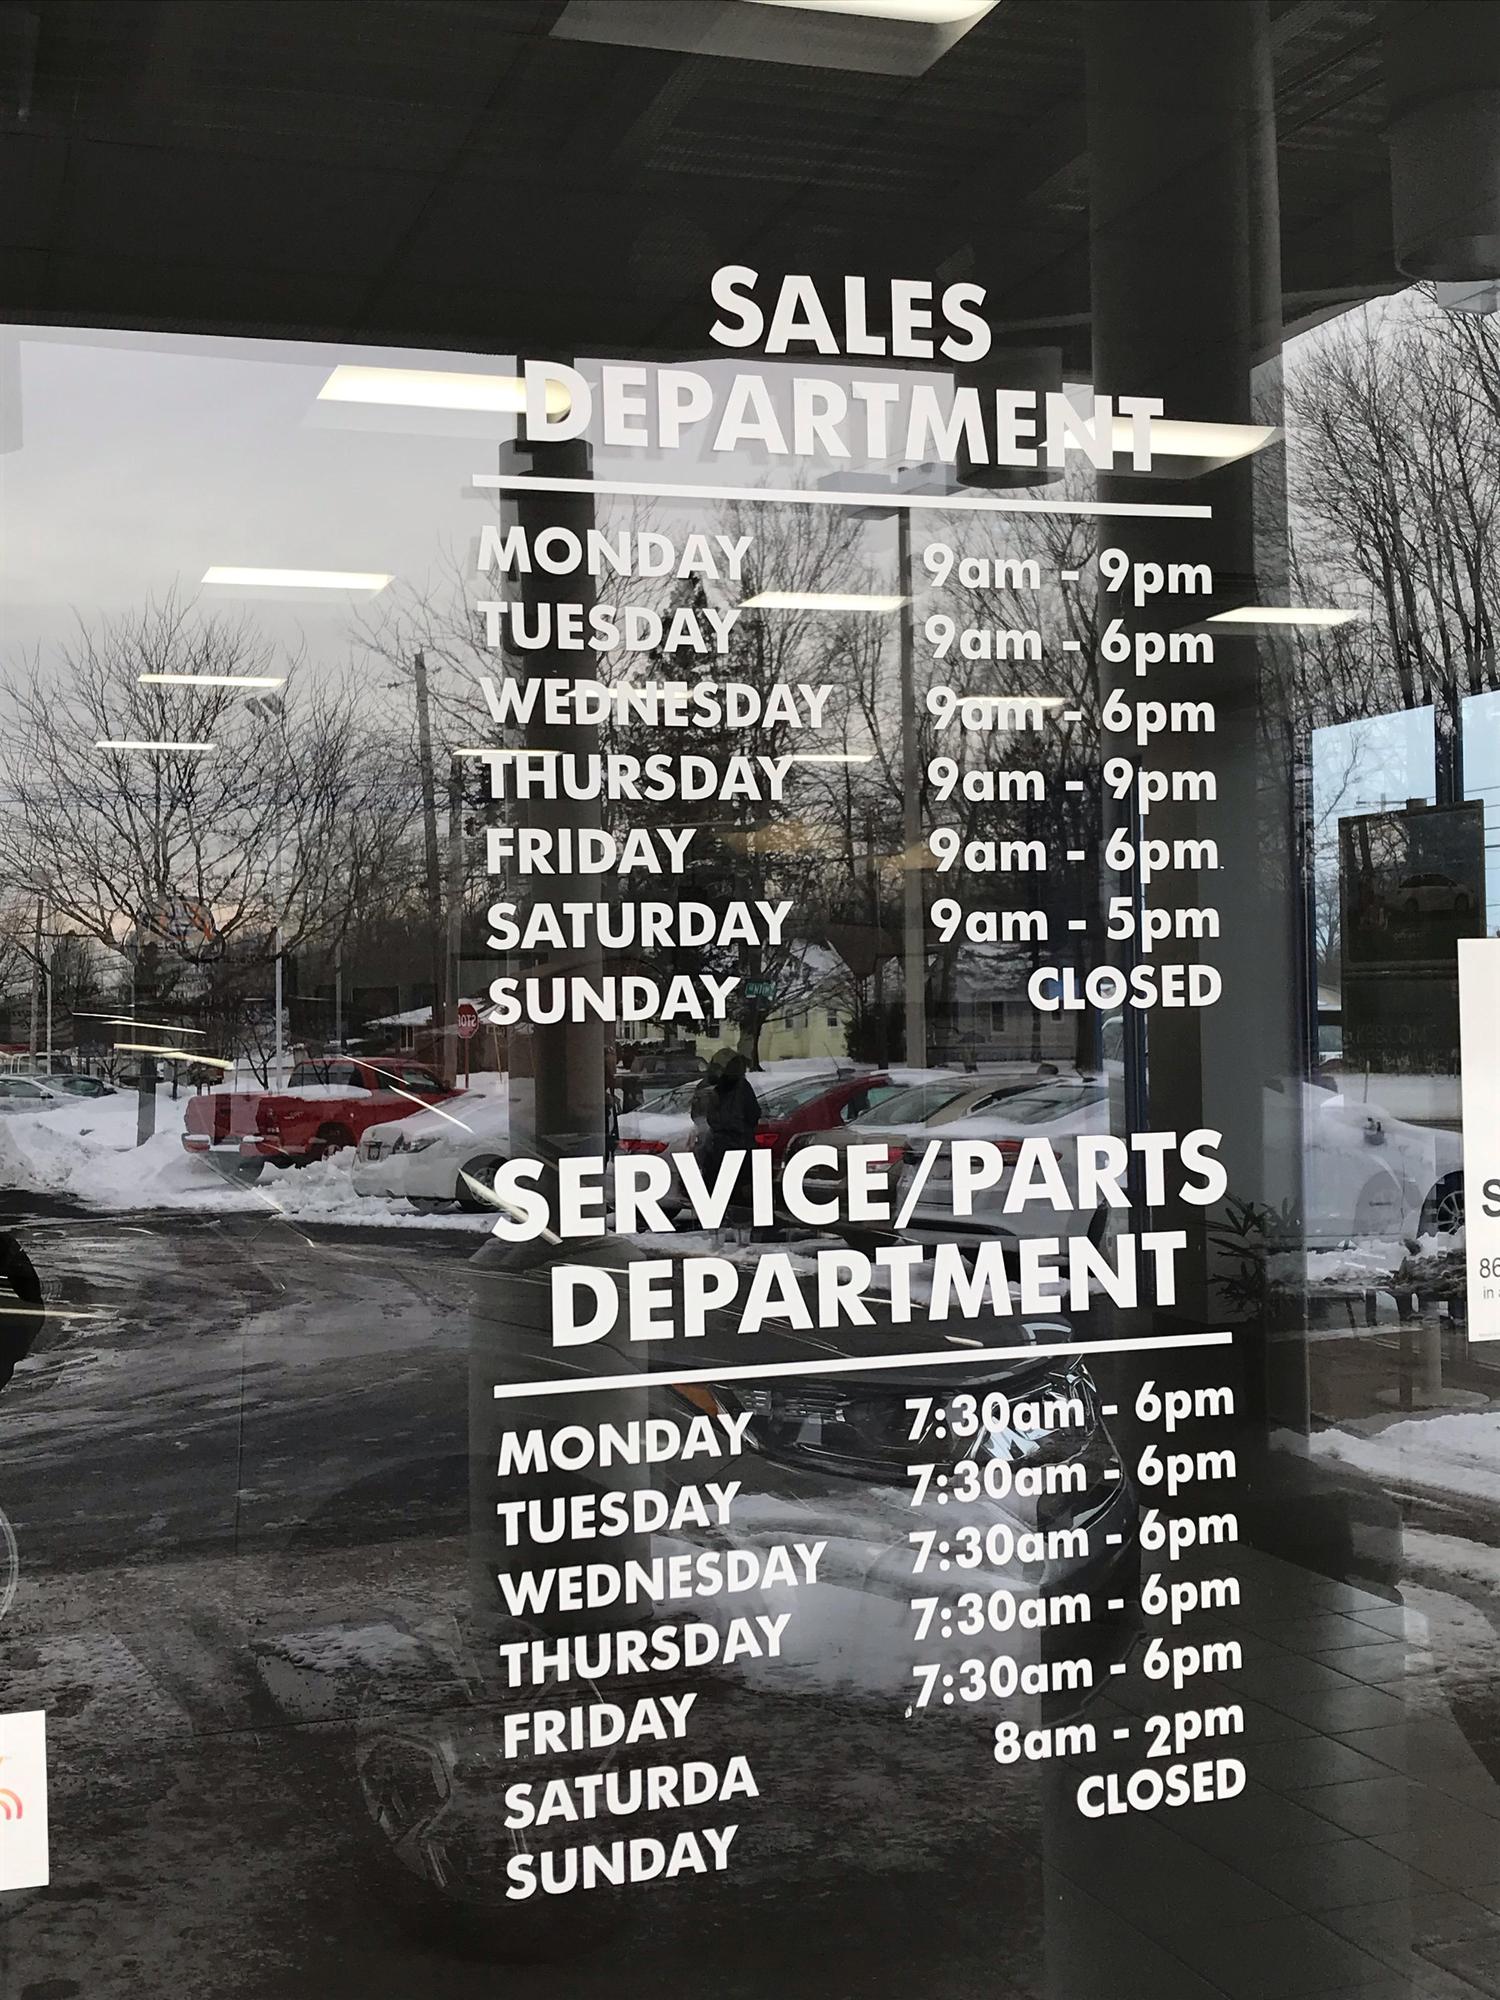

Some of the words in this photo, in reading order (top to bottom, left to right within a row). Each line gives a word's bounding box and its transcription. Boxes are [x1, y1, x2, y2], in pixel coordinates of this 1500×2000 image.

[709, 264, 992, 362] SALES
[524, 359, 1164, 472] DEPARTMENT
[477, 526, 754, 580] MONDAY
[923, 544, 1041, 591] 9am
[1061, 570, 1079, 581] -
[1099, 549, 1213, 607] 9pm
[477, 601, 740, 654] TUESDAY
[924, 615, 1042, 661] 9am
[1062, 641, 1080, 651] -
[1101, 619, 1214, 676] 6pm
[480, 676, 834, 729] WEDNESDAY
[926, 686, 1044, 732] 9am
[1064, 711, 1081, 722] -
[1101, 689, 1216, 746] 6pm
[481, 752, 794, 802] THURSDAY
[928, 757, 1046, 802] 9am
[1065, 781, 1082, 791] -
[1103, 758, 1217, 814] 9pm
[487, 828, 697, 874] FRIDAY
[929, 828, 1048, 873] 9am
[1067, 851, 1084, 861] -
[1105, 827, 1218, 883] 6pm
[486, 900, 794, 949] SATURDAY
[930, 899, 1048, 944] 9am
[1068, 921, 1086, 931] -
[1107, 897, 1220, 952] 5pm
[488, 974, 740, 1024] SUNDAY
[1028, 966, 1222, 1011] CLOSED
[491, 1129, 1228, 1243] SERVICE/PARTS
[551, 1231, 1188, 1348] DEPARTMENT
[498, 1411, 754, 1476] MONDAY
[904, 1391, 1085, 1441] 7:30am
[1102, 1404, 1118, 1416] -
[1135, 1381, 1234, 1437] 6pm
[497, 1481, 742, 1547] TUESDAY
[906, 1455, 1087, 1508] 7:30am
[1104, 1468, 1120, 1480] -
[1137, 1445, 1236, 1500] 6pm
[499, 1541, 828, 1617] WEDNESDAY
[909, 1521, 1089, 1574] 7:30am
[1106, 1532, 1122, 1544] -
[1139, 1509, 1239, 1561] 6pm
[500, 1613, 792, 1689] THURSDAY
[911, 1587, 1091, 1641] 7:30am
[1108, 1598, 1124, 1610] -
[1141, 1572, 1241, 1626] 6pm
[503, 1692, 698, 1759] FRIDAY
[912, 1654, 1092, 1708] 7:30am
[1110, 1663, 1126, 1674] -
[1142, 1638, 1242, 1691] 6pm
[504, 1755, 760, 1830] SATURDA
[994, 1716, 1096, 1765] 8am
[1112, 1728, 1128, 1740] -
[1146, 1703, 1244, 1759] 2pm
[506, 1824, 739, 1900] SUNDAY
[1076, 1757, 1246, 1818] CLOSED
